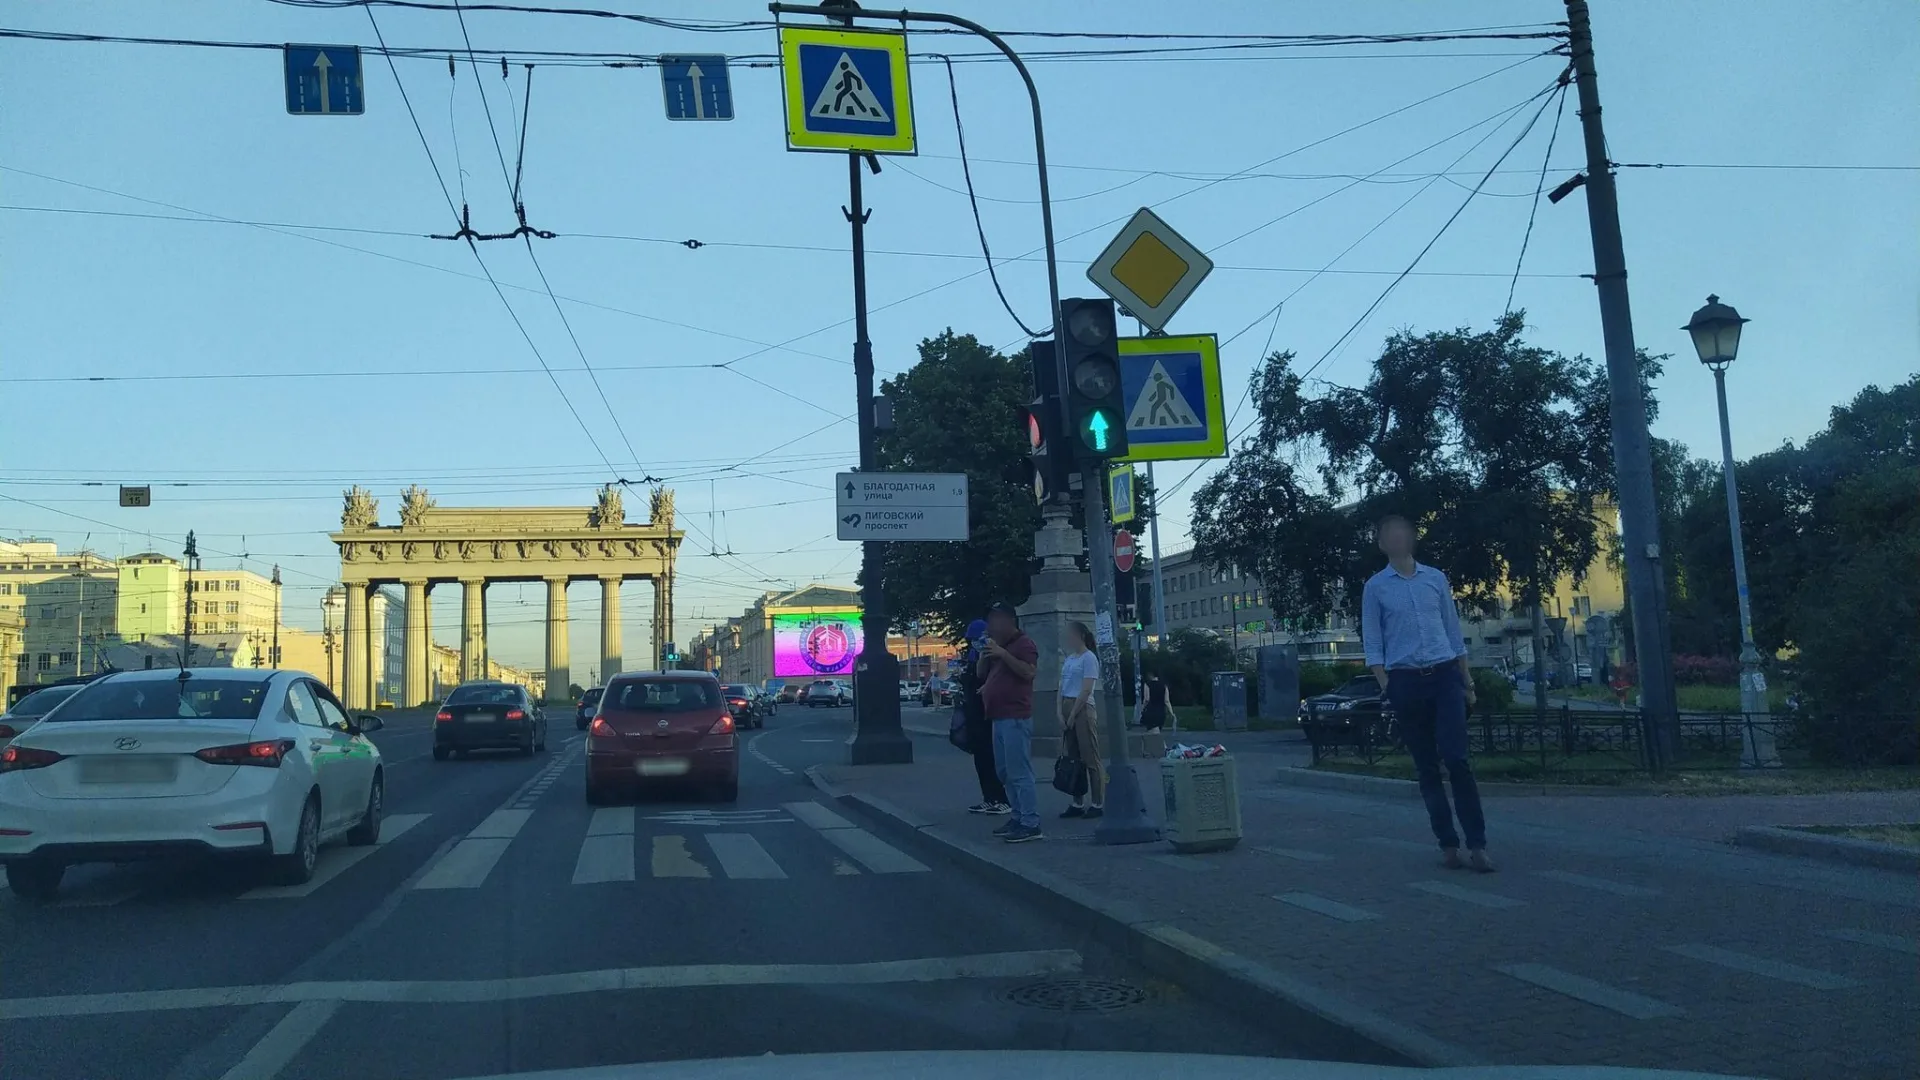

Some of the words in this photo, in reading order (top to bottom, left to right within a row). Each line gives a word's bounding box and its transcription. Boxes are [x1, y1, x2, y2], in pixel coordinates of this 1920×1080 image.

[863, 482, 936, 492] БЛАГОДАТНАЯ
[128, 496, 141, 505] 15
[864, 492, 893, 501] улица
[865, 510, 924, 520] ЛИГОВСКИЙ
[864, 522, 909, 532] проспект
